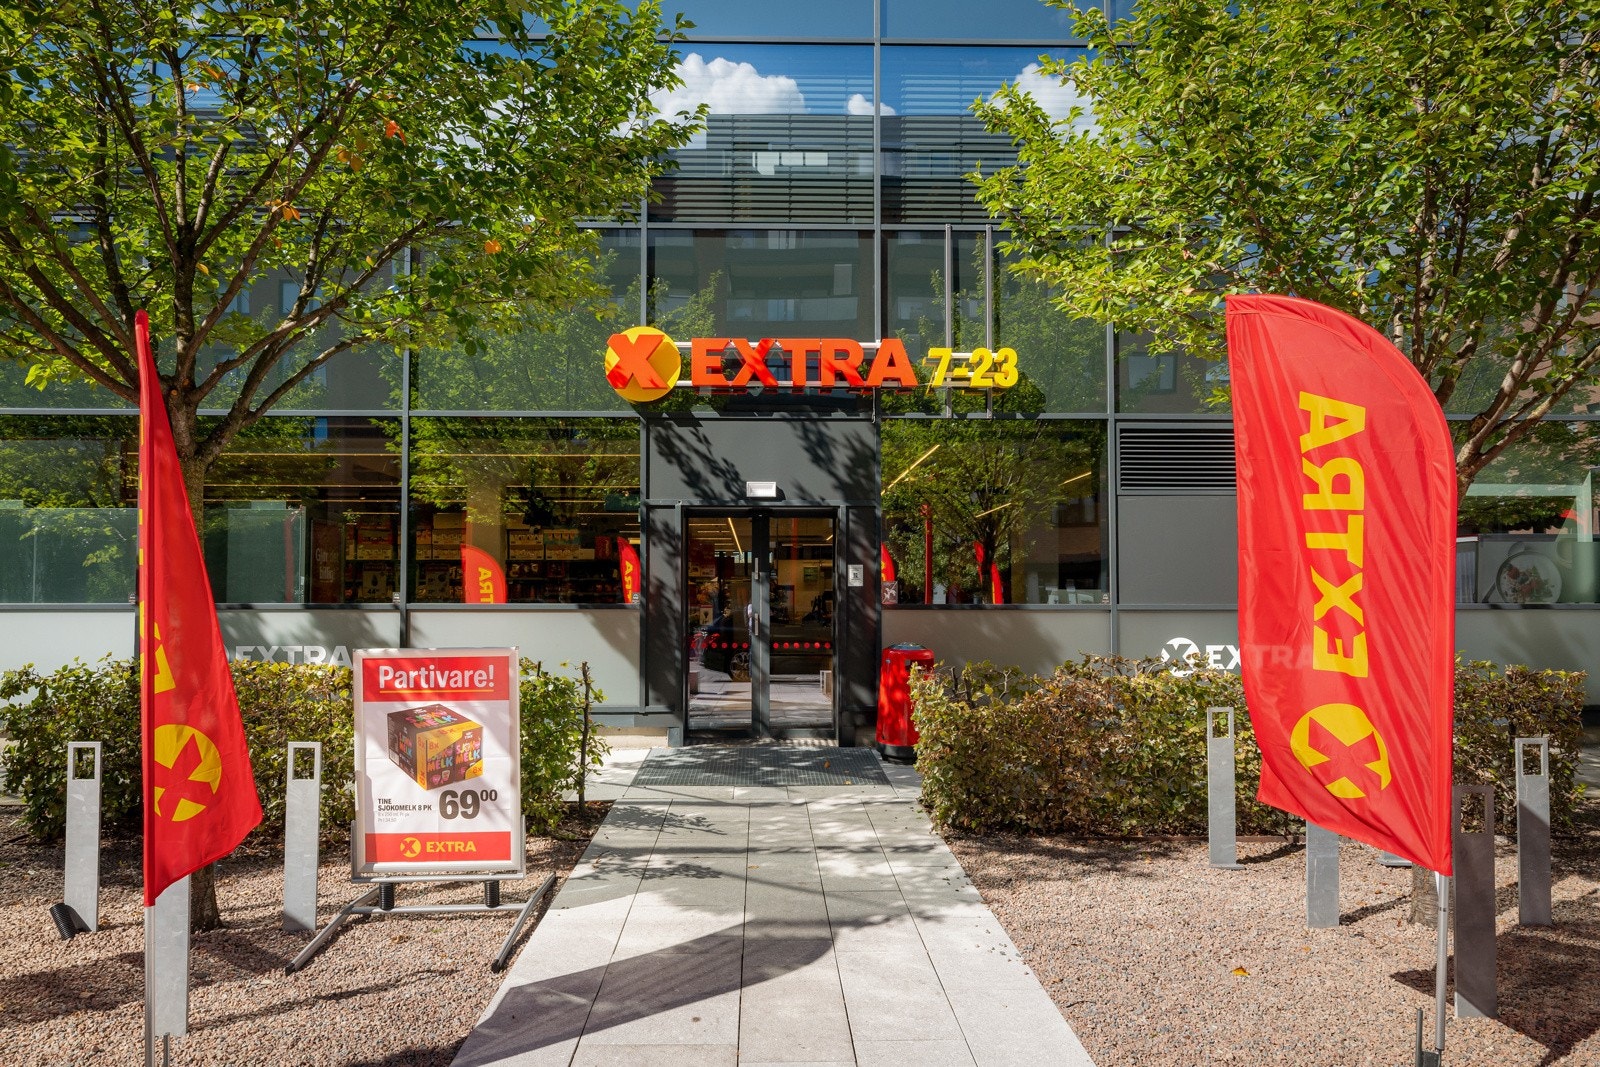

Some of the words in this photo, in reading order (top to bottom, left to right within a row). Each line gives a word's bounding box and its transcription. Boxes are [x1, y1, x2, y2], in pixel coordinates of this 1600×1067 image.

[692, 337, 919, 389] EXTRA
[924, 347, 1019, 389] 7-23
[379, 664, 495, 690] Partivare!
[439, 789, 481, 820] 69
[480, 789, 498, 802] 00
[426, 841, 477, 853] EXTRA
